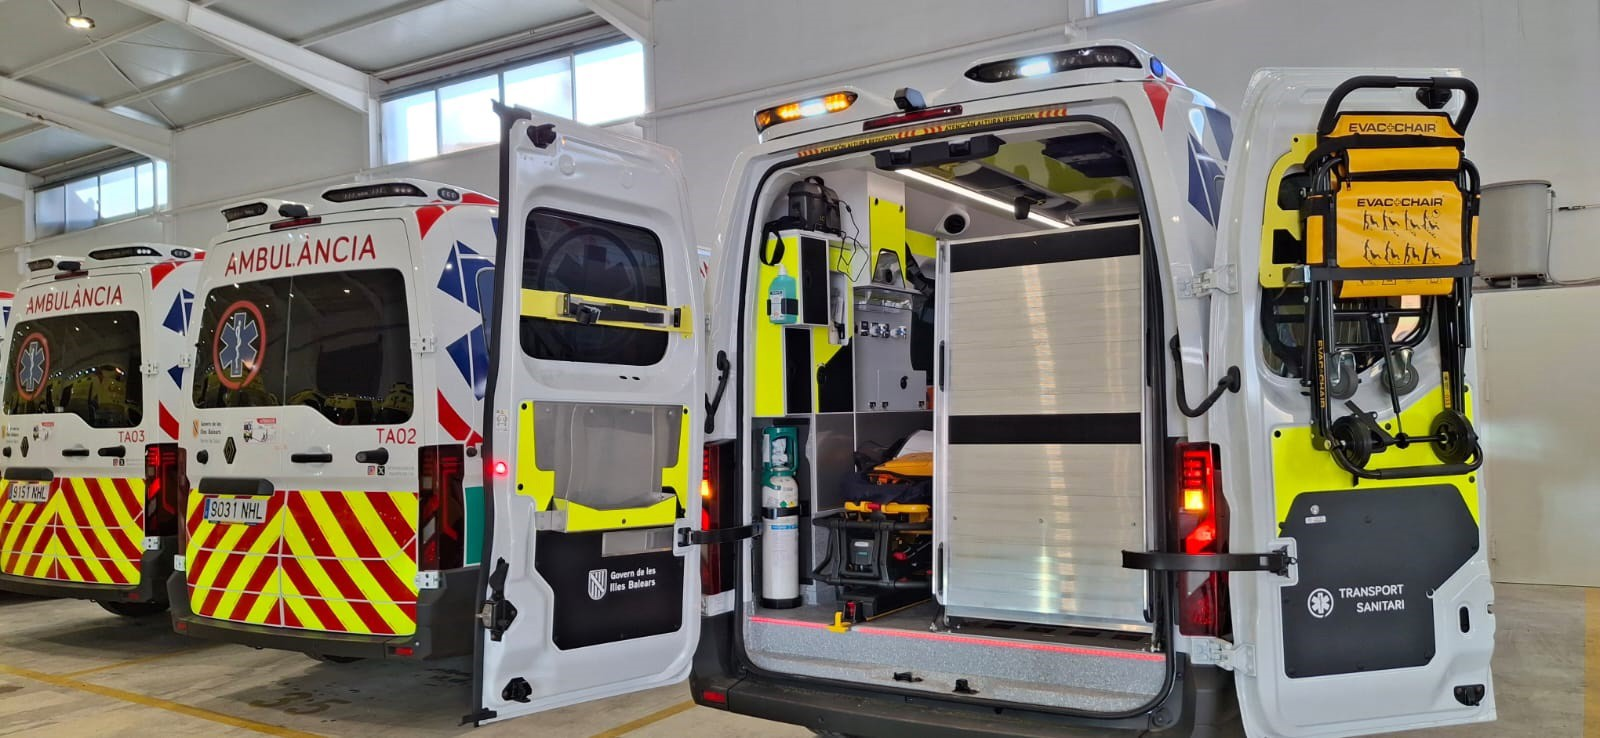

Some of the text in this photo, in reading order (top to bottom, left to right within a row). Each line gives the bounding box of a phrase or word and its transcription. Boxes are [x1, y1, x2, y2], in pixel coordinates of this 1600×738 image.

[977, 117, 1001, 126] ALTURA
[1002, 113, 1036, 123] REDUCIDA
[224, 233, 377, 277] AMBULÀNCIA
[25, 283, 123, 315] AMBULÀNCIA
[118, 430, 145, 443] TA03
[376, 427, 417, 444] TA02
[241, 502, 262, 520] NHL
[610, 570, 635, 580] Govern
[646, 566, 656, 575] les
[609, 579, 656, 592] Illes Balears
[1338, 583, 1405, 599] TRANSPORT
[1356, 599, 1405, 613] SANITARI
